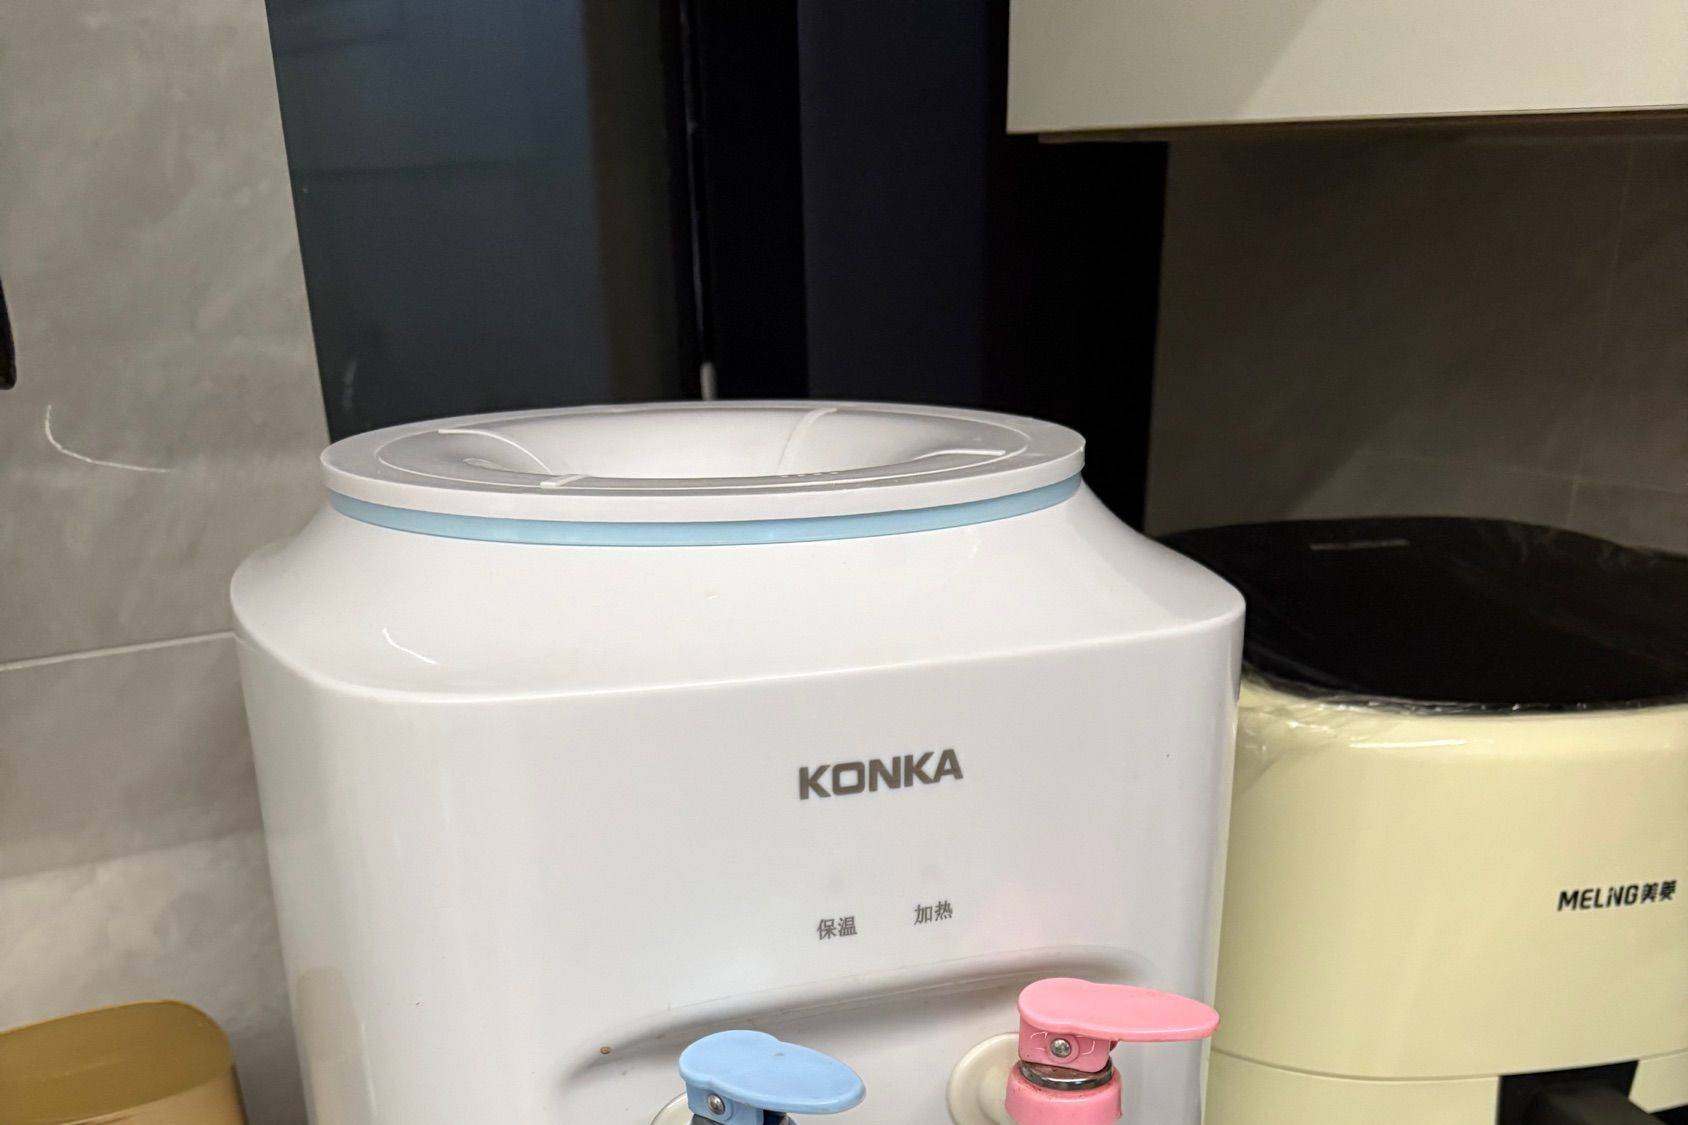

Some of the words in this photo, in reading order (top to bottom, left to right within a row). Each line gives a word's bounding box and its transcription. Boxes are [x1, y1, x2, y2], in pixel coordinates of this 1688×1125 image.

[799, 748, 964, 800] KONKA
[913, 900, 954, 926] 加热
[816, 915, 858, 940] 保温
